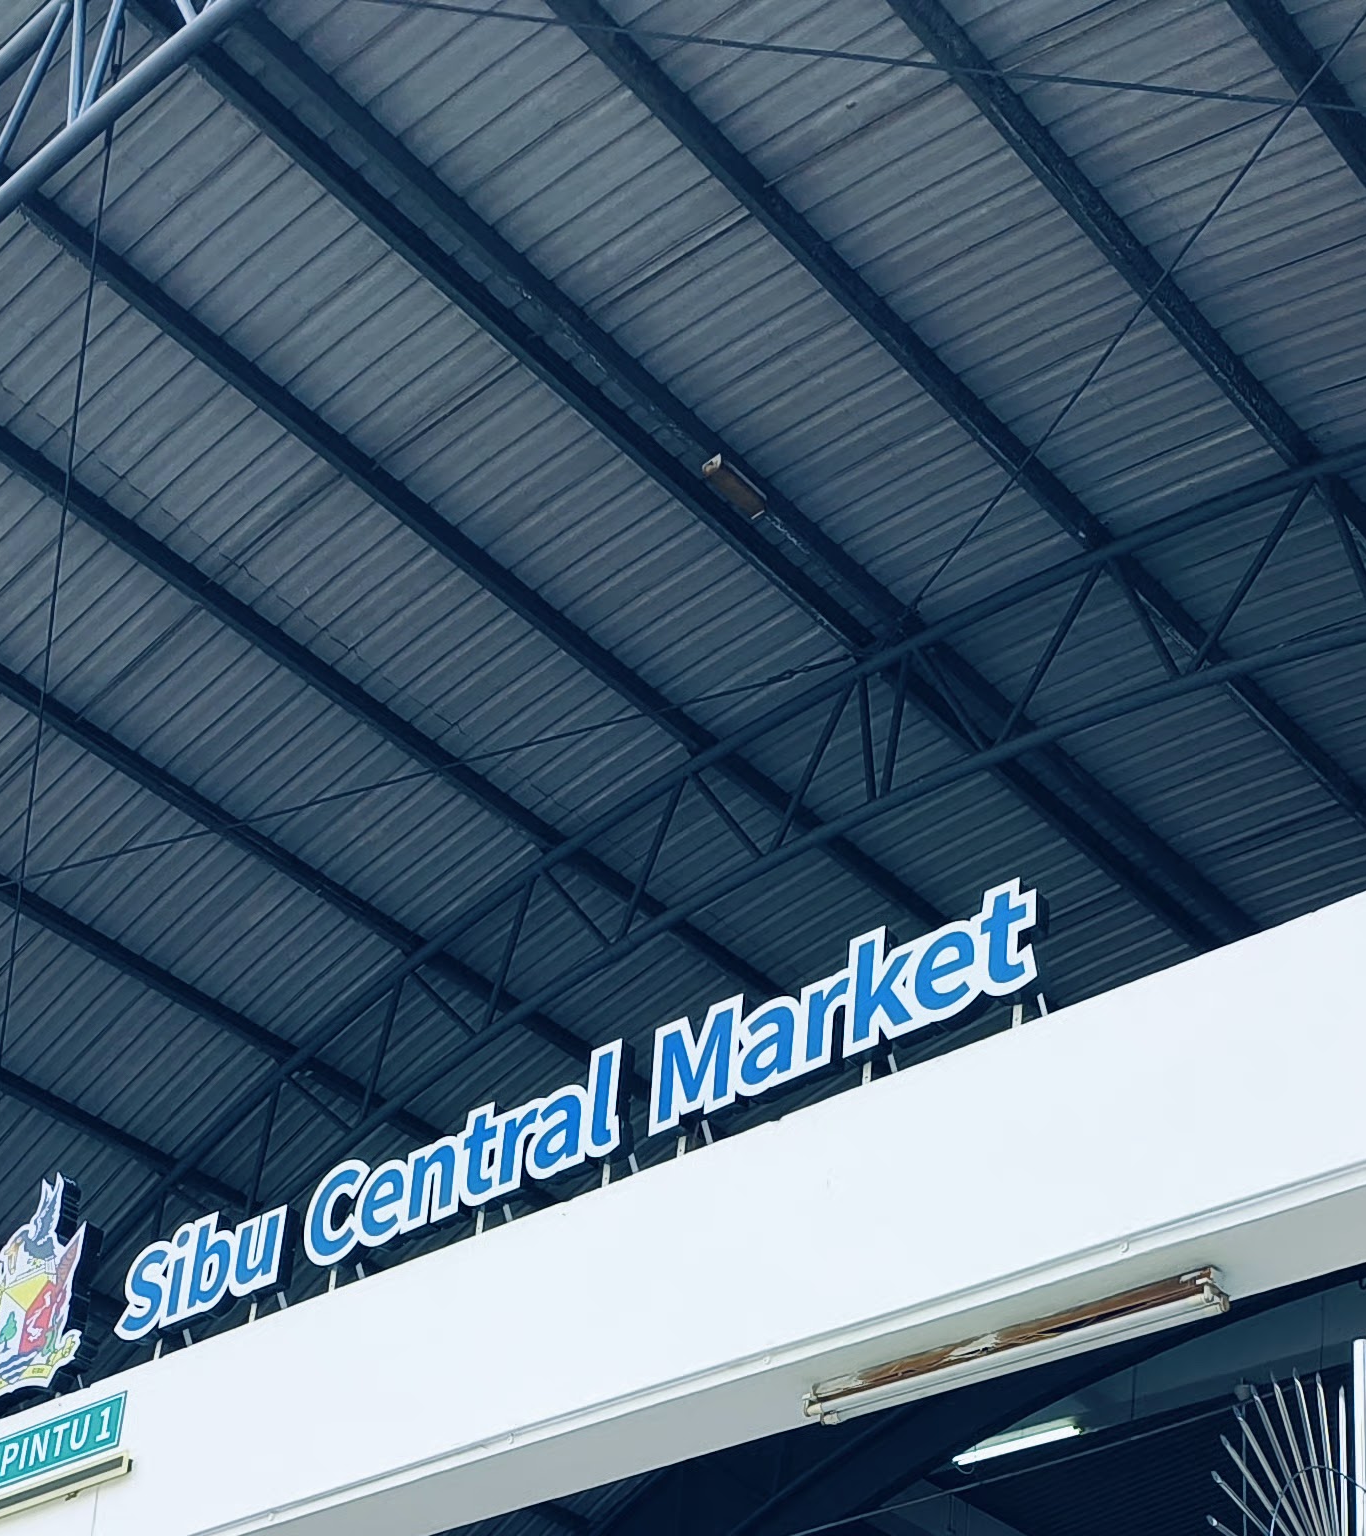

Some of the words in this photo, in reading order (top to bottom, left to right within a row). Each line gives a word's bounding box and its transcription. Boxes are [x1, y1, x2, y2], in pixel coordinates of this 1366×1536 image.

[117, 1207, 286, 1338] Sibu
[306, 1042, 620, 1263] Central
[651, 881, 1035, 1133] Market
[0, 1413, 91, 1477] PINTU
[95, 1406, 112, 1443] 1
